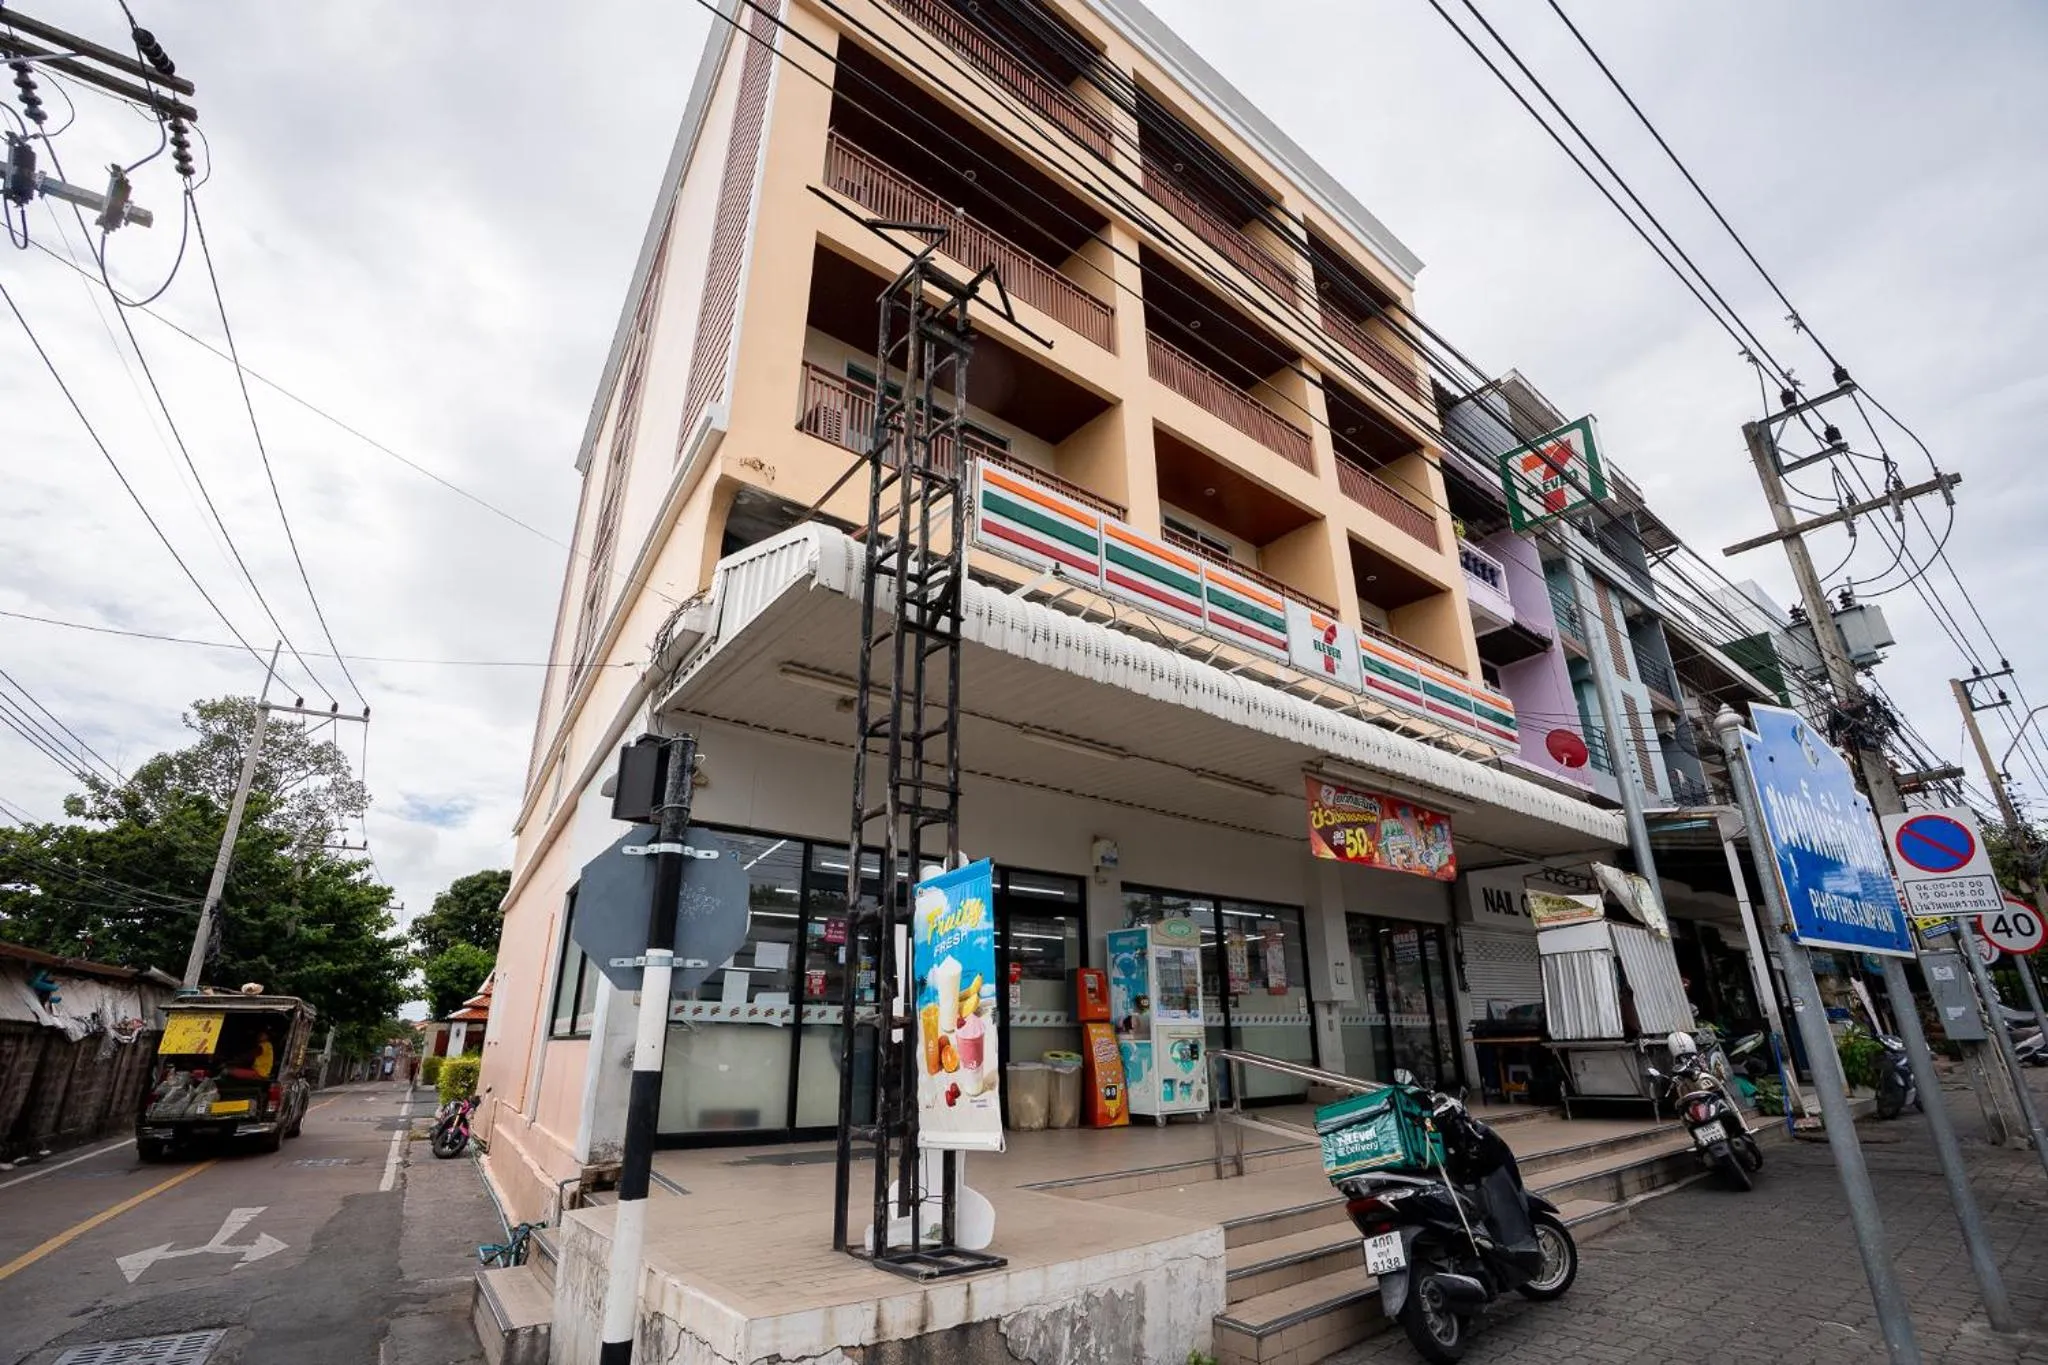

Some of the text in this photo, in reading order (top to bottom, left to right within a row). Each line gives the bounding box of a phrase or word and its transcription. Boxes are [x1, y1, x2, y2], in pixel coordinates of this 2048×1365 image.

[1482, 887, 1519, 916] NAIL
[1808, 888, 1897, 933] PHOTHISAMPHAN
[926, 897, 986, 945] Fruity
[1992, 913, 2035, 938] 40
[933, 928, 969, 957] FRESH
[1372, 1256, 1401, 1272] 3138
